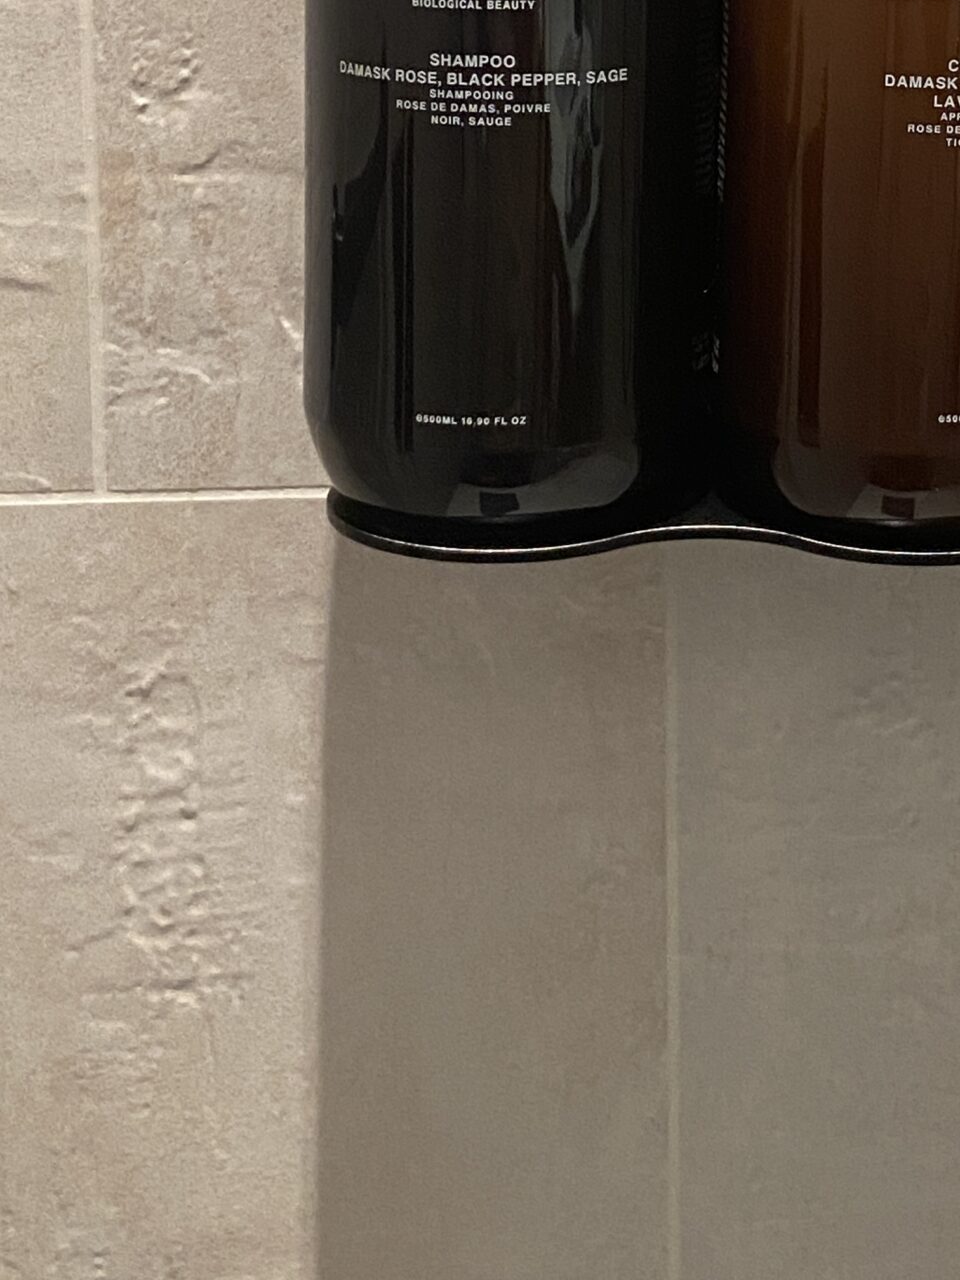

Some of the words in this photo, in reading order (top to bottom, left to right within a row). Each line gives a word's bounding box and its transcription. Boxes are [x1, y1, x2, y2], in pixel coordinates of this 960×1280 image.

[486, 0, 536, 11] BEAUTY
[429, 53, 517, 68] SHAMPOO
[339, 59, 391, 81] DAMASK
[395, 70, 443, 87] ROSE,
[446, 72, 505, 87] BLACK
[510, 72, 581, 87] PEPPER,
[585, 68, 629, 85] SAGE
[884, 74, 958, 90] DAMASK
[429, 88, 514, 101] SHAMPOOING
[395, 99, 427, 111] ROSE
[430, 102, 447, 112] DE
[450, 102, 500, 114] DAMAS,
[504, 103, 551, 113] POIVRE
[430, 115, 465, 127] NOIR,
[468, 116, 512, 127] SAUGE
[907, 123, 941, 134] ROSE
[494, 416, 508, 426] FL
[511, 415, 527, 425] OZ
